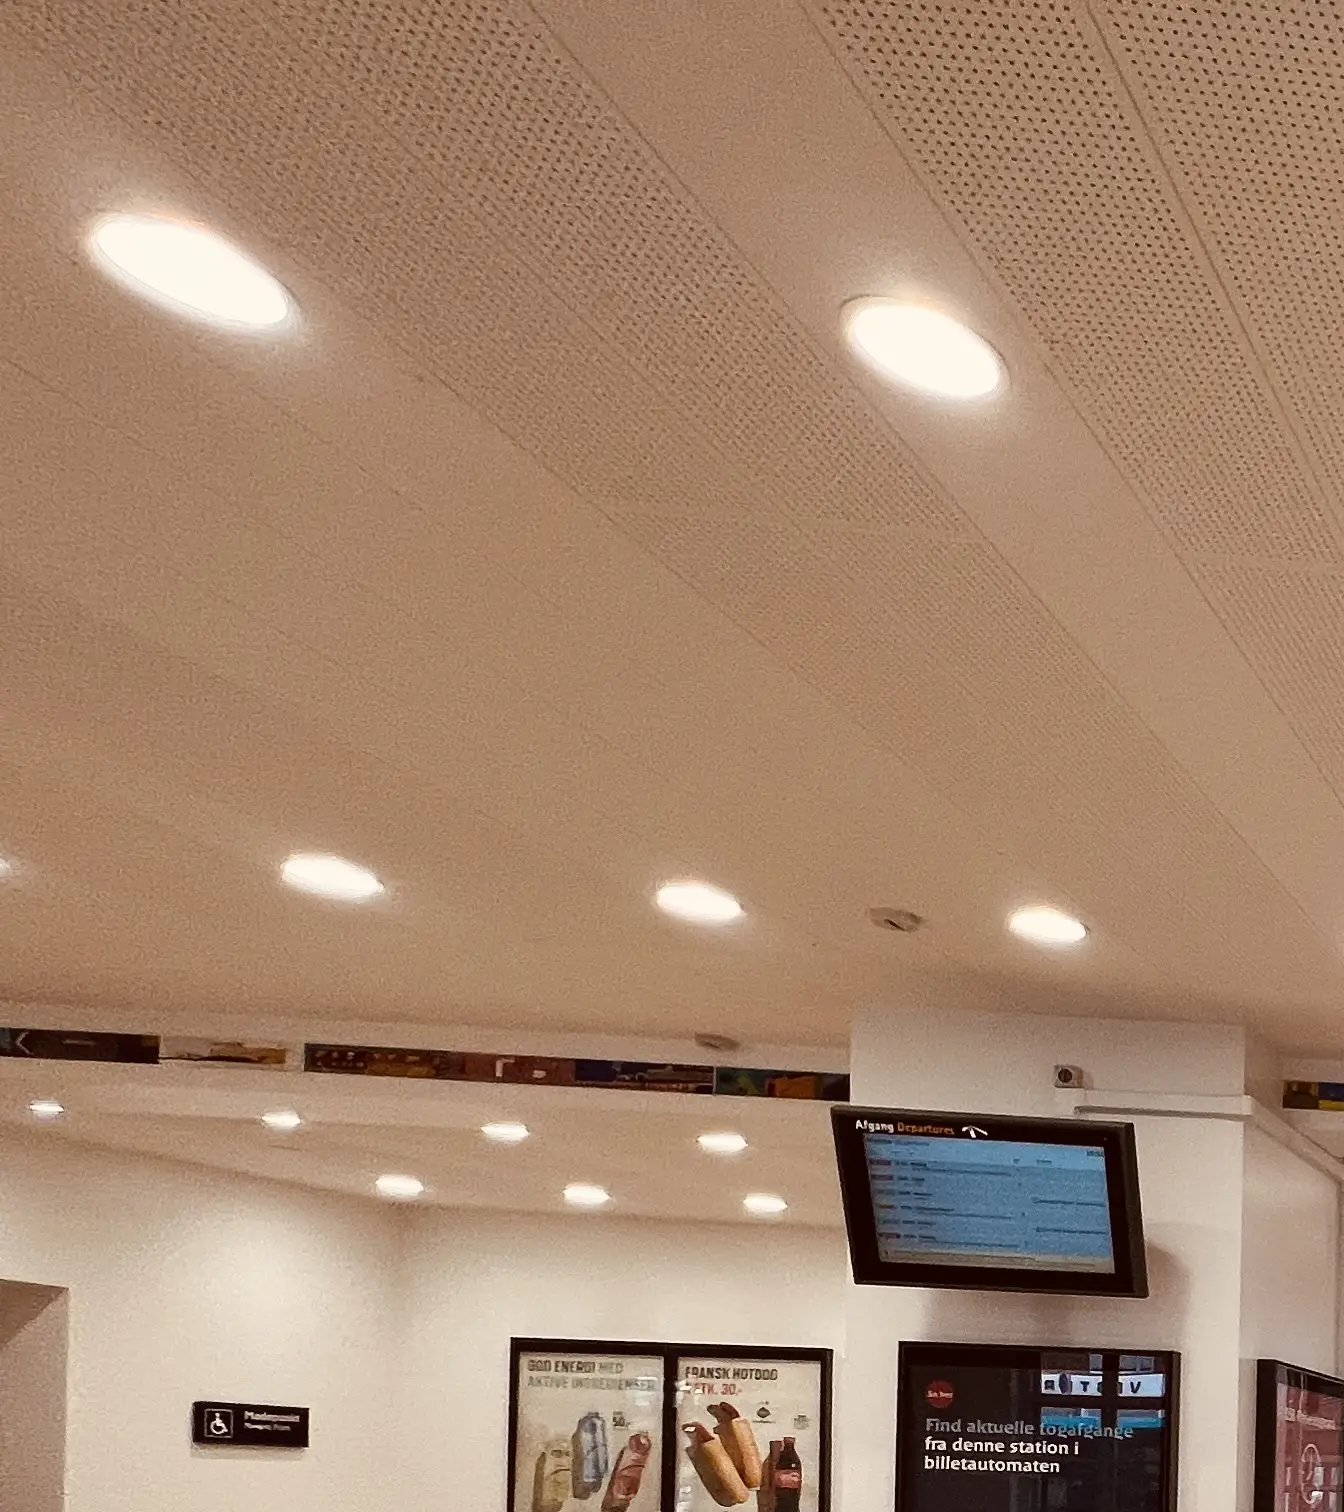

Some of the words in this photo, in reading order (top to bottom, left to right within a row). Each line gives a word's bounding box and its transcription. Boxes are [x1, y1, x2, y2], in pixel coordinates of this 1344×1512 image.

[855, 1119, 895, 1134] Afgang
[897, 1121, 956, 1135] Departures
[685, 1366, 729, 1380] FRANSK
[732, 1368, 779, 1381] HOTDOG
[925, 1417, 962, 1433] Find
[966, 1420, 1035, 1435] aktuelle
[1040, 1422, 1135, 1441] togafgange
[924, 1436, 947, 1451] fra
[952, 1437, 1005, 1453] denne
[1009, 1440, 1070, 1455] station
[1074, 1441, 1079, 1455] i
[924, 1455, 1060, 1474] billetautomaten
